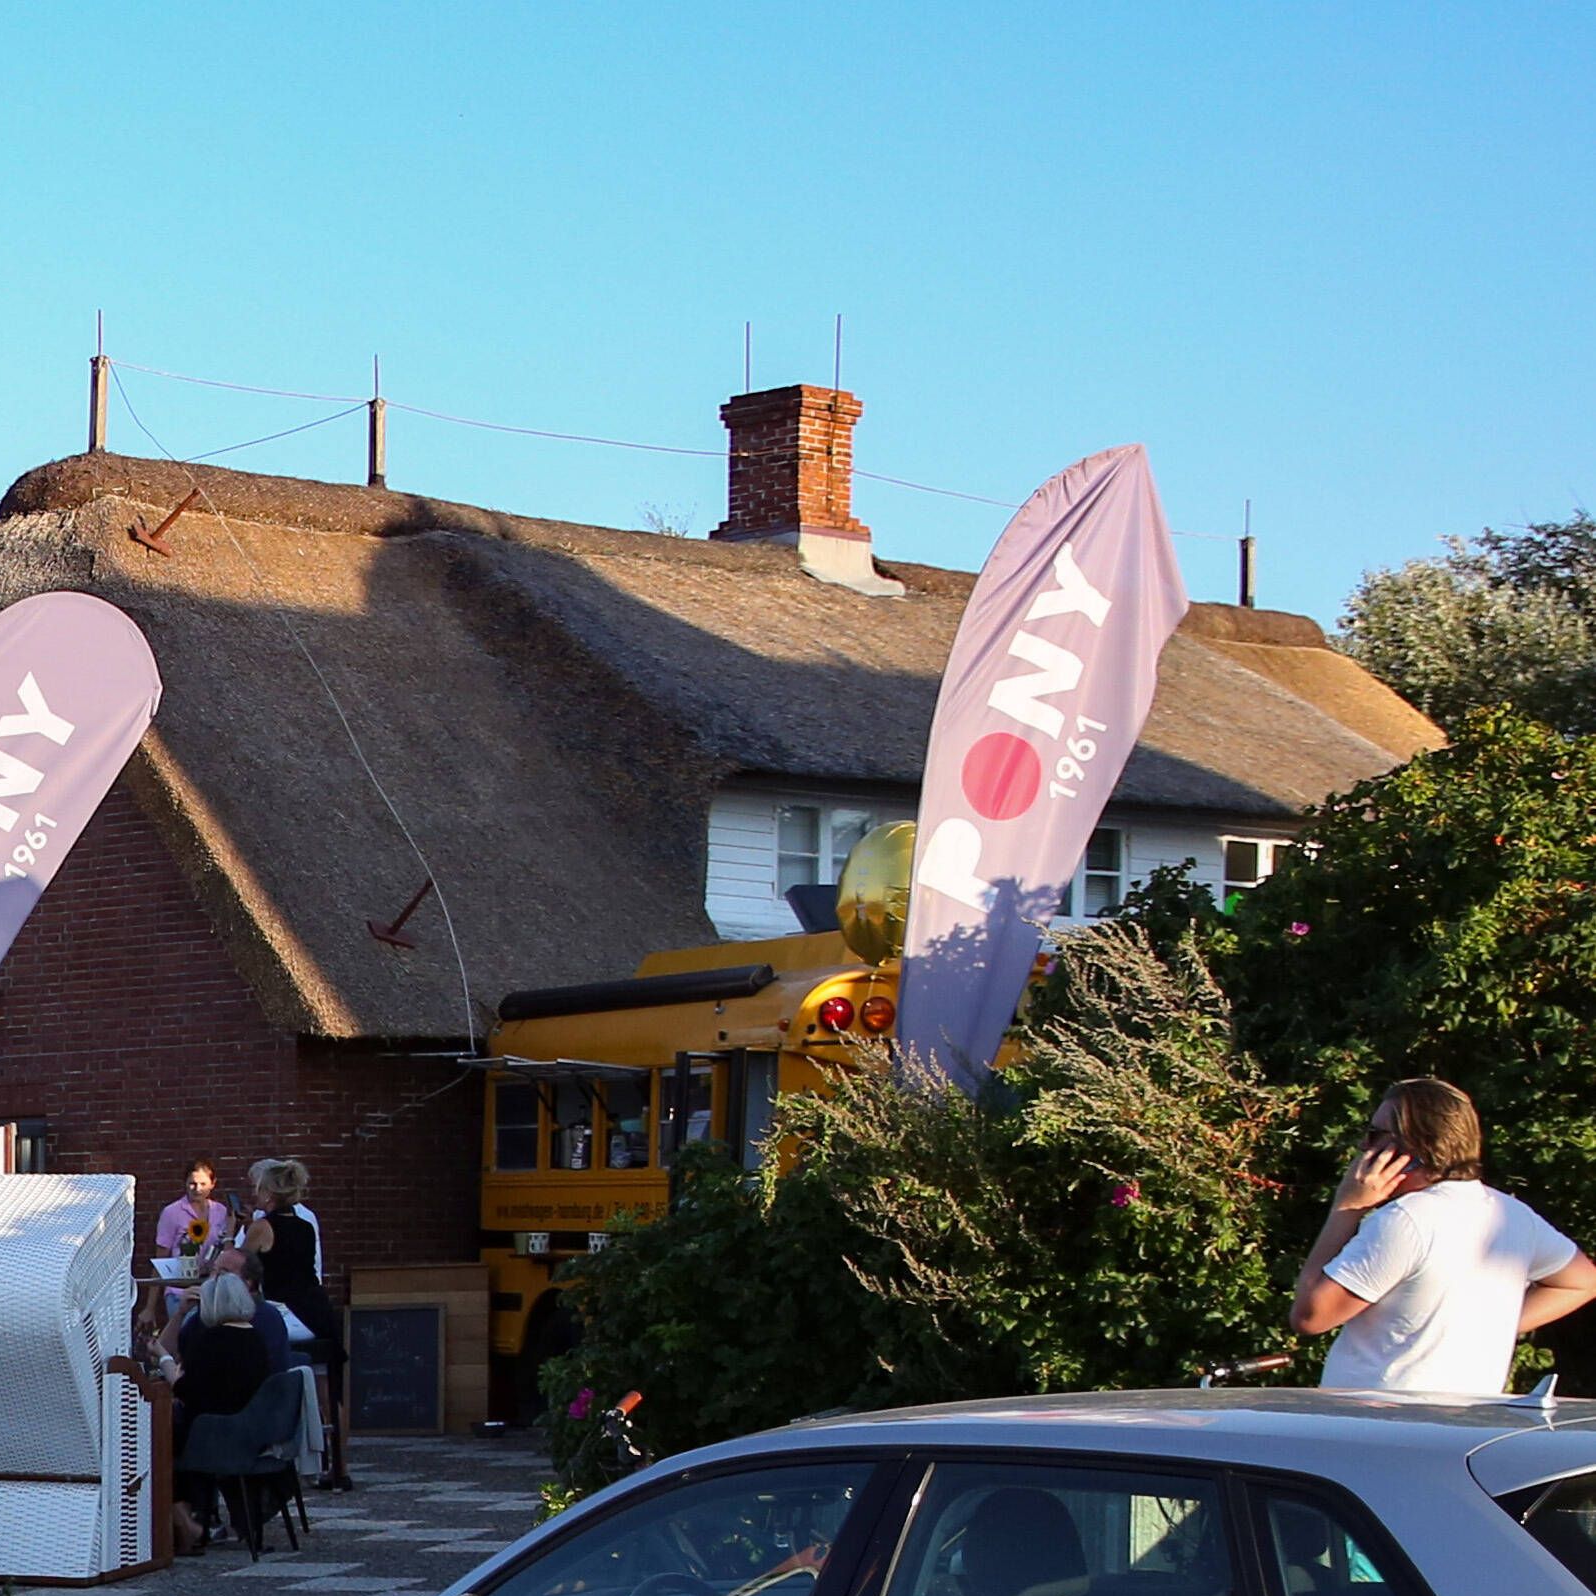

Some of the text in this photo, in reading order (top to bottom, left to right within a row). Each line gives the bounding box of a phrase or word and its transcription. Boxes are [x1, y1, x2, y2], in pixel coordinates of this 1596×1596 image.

[917, 541, 1114, 914] PONY
[1048, 715, 1108, 801] 1961
[4, 813, 58, 880] 1961
